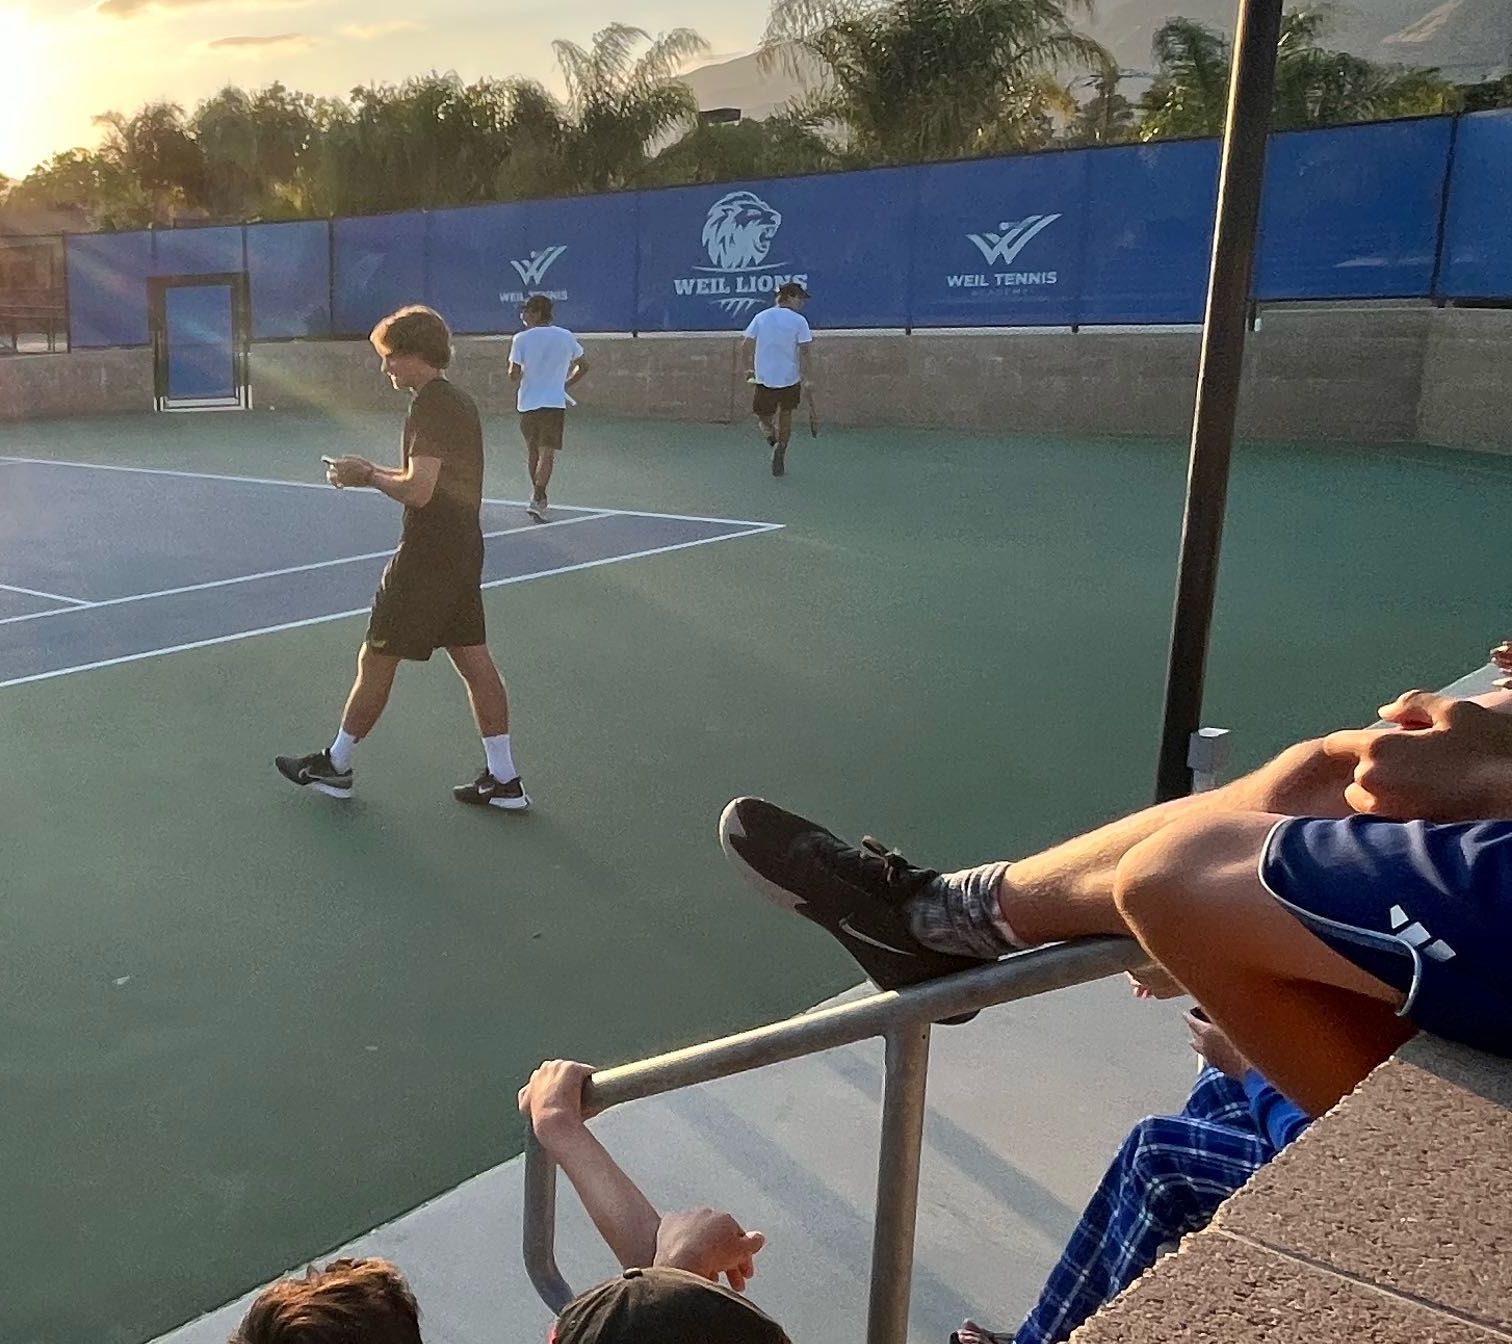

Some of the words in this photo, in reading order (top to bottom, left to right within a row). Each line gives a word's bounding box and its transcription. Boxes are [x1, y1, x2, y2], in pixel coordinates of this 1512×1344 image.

[674, 277, 730, 296] WEIL
[736, 272, 809, 293] LIONS
[946, 274, 989, 287] WEIL
[994, 271, 1057, 286] TENNIS
